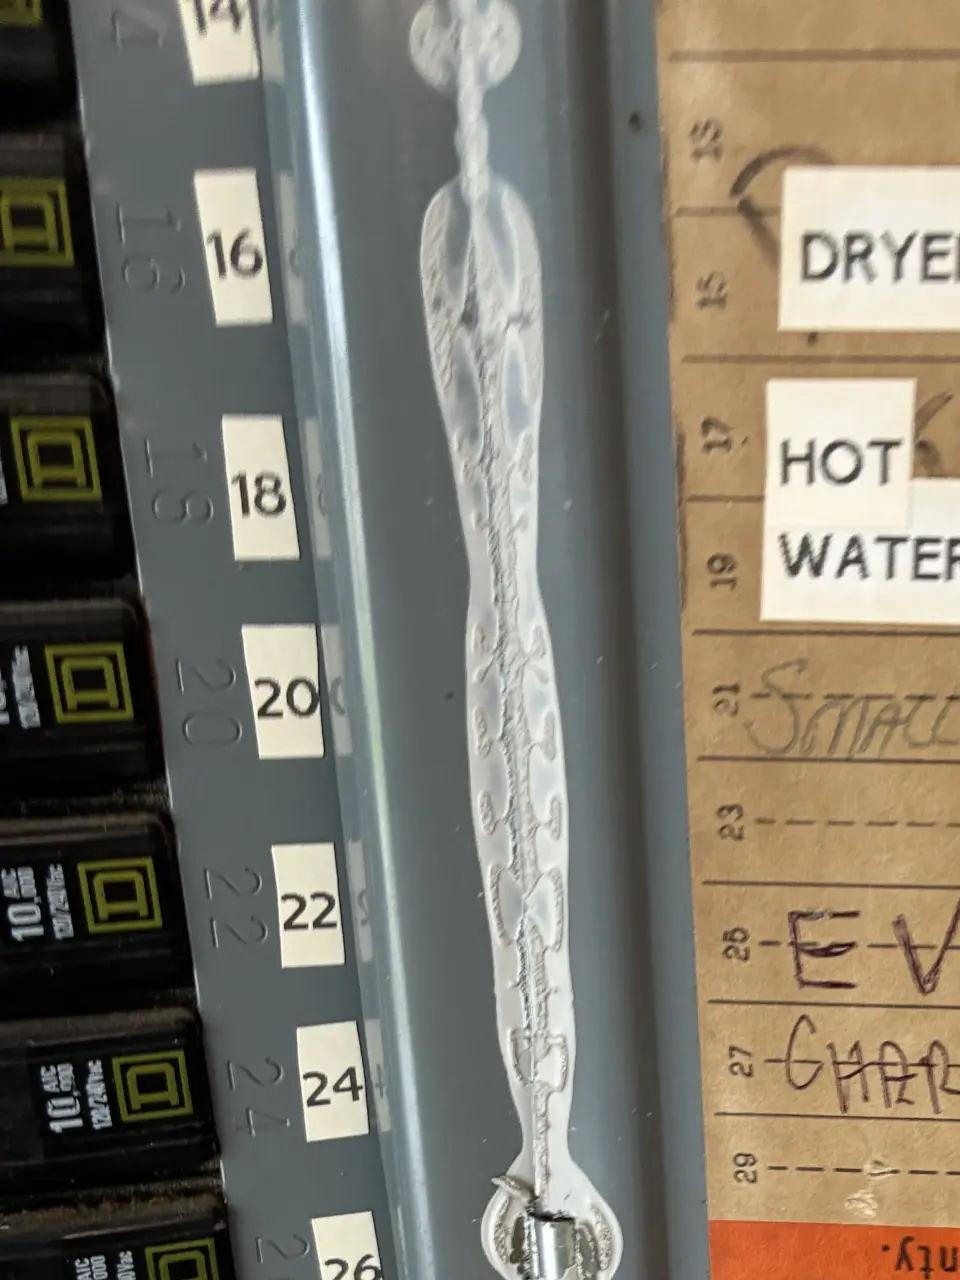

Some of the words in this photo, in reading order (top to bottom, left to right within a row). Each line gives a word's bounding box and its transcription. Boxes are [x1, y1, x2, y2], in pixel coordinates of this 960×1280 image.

[206, 226, 263, 279] 16
[702, 417, 732, 455] 17
[779, 437, 903, 487] HOT
[231, 471, 287, 519] 18
[708, 552, 738, 589] 19
[176, 657, 243, 748] 20
[254, 678, 319, 720] 20
[712, 682, 741, 717] 21
[717, 802, 745, 841] 23
[204, 866, 269, 949] 22
[281, 892, 338, 932] 22
[722, 926, 751, 962] 25
[728, 1046, 754, 1078] 27
[302, 1066, 363, 1108] 24
[733, 1151, 758, 1184] 29
